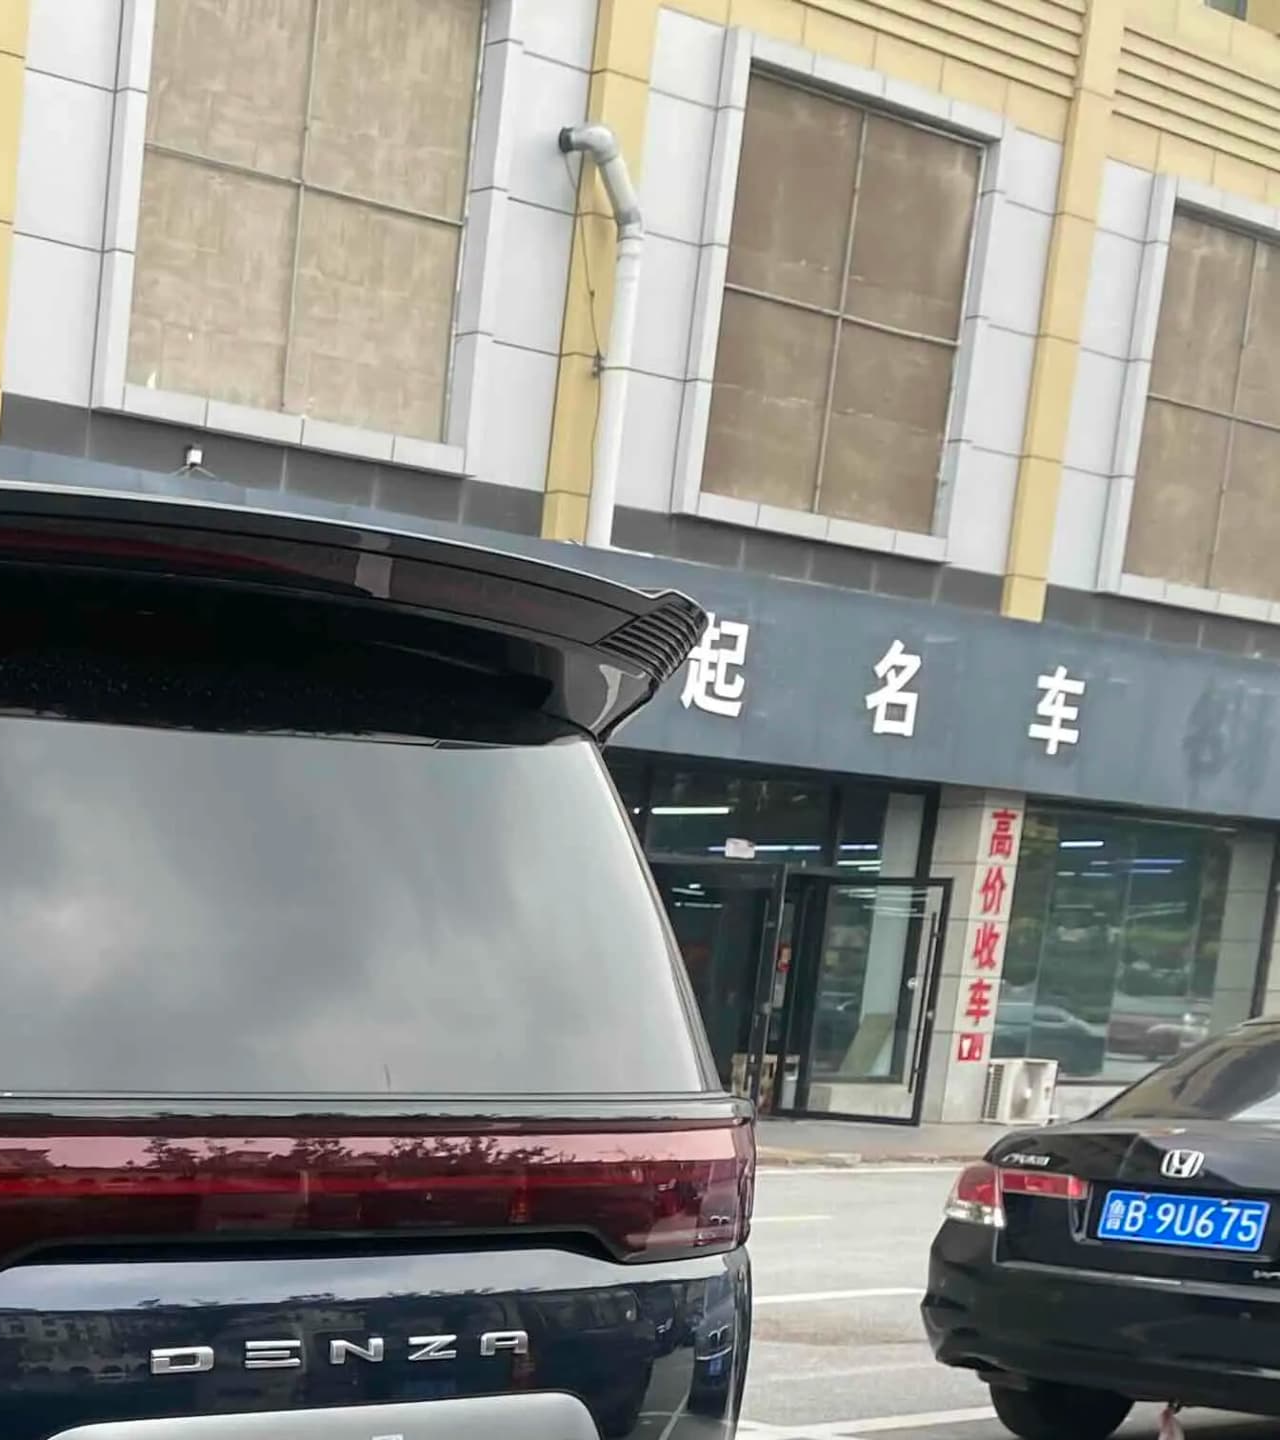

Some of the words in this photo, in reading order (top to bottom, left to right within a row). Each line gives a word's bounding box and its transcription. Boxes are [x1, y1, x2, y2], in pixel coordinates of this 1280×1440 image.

[679, 611, 1087, 755] 起名车
[149, 1329, 530, 1376] DENZA
